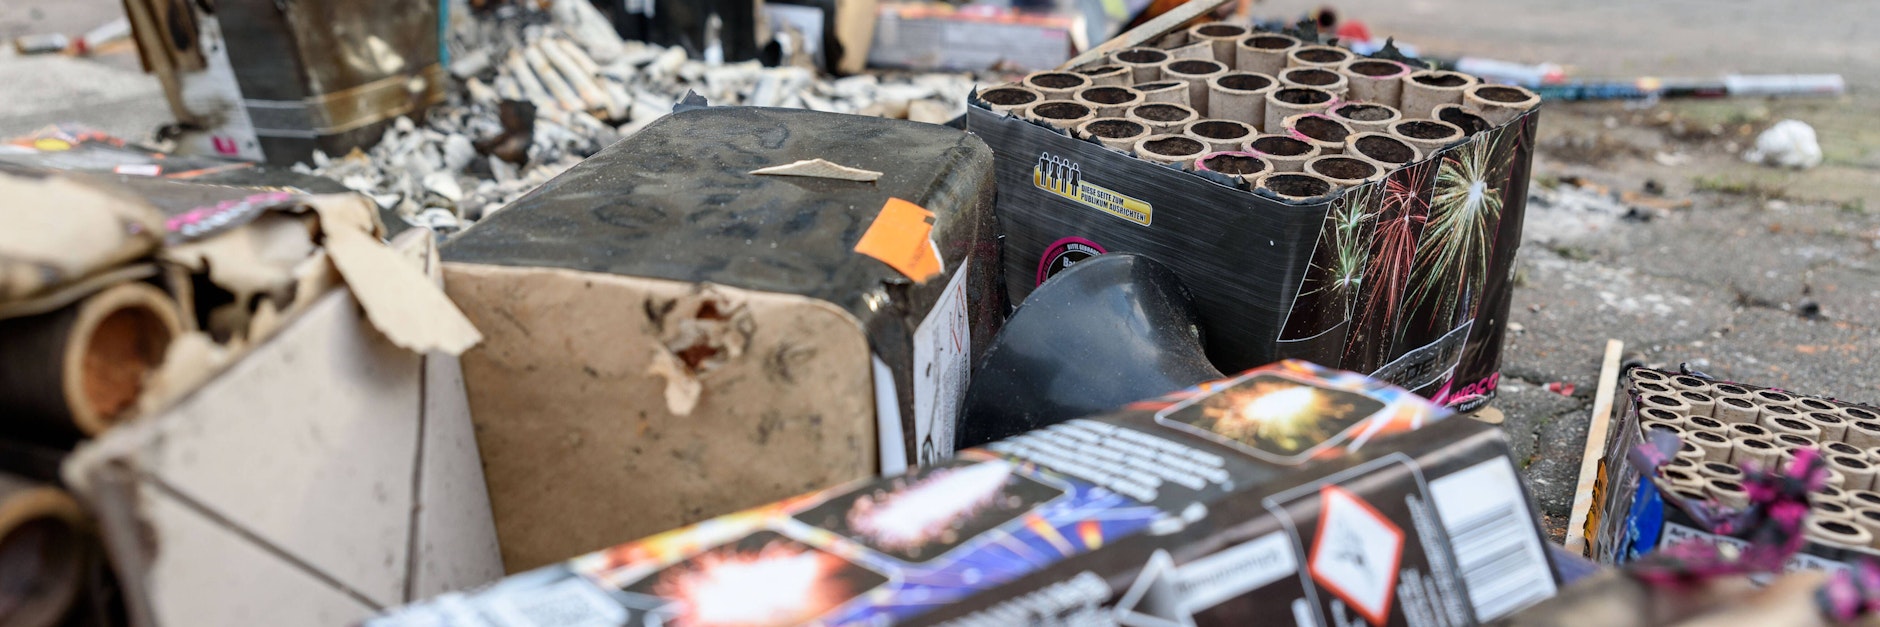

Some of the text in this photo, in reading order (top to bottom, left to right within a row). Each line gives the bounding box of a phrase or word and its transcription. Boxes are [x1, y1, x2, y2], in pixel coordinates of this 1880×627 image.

[1080, 193, 1146, 222] PUBLIKUM AUSRICHTEN!
[1081, 184, 1124, 206] DIESE SEITE ZUM
[1450, 371, 1500, 402] weco
